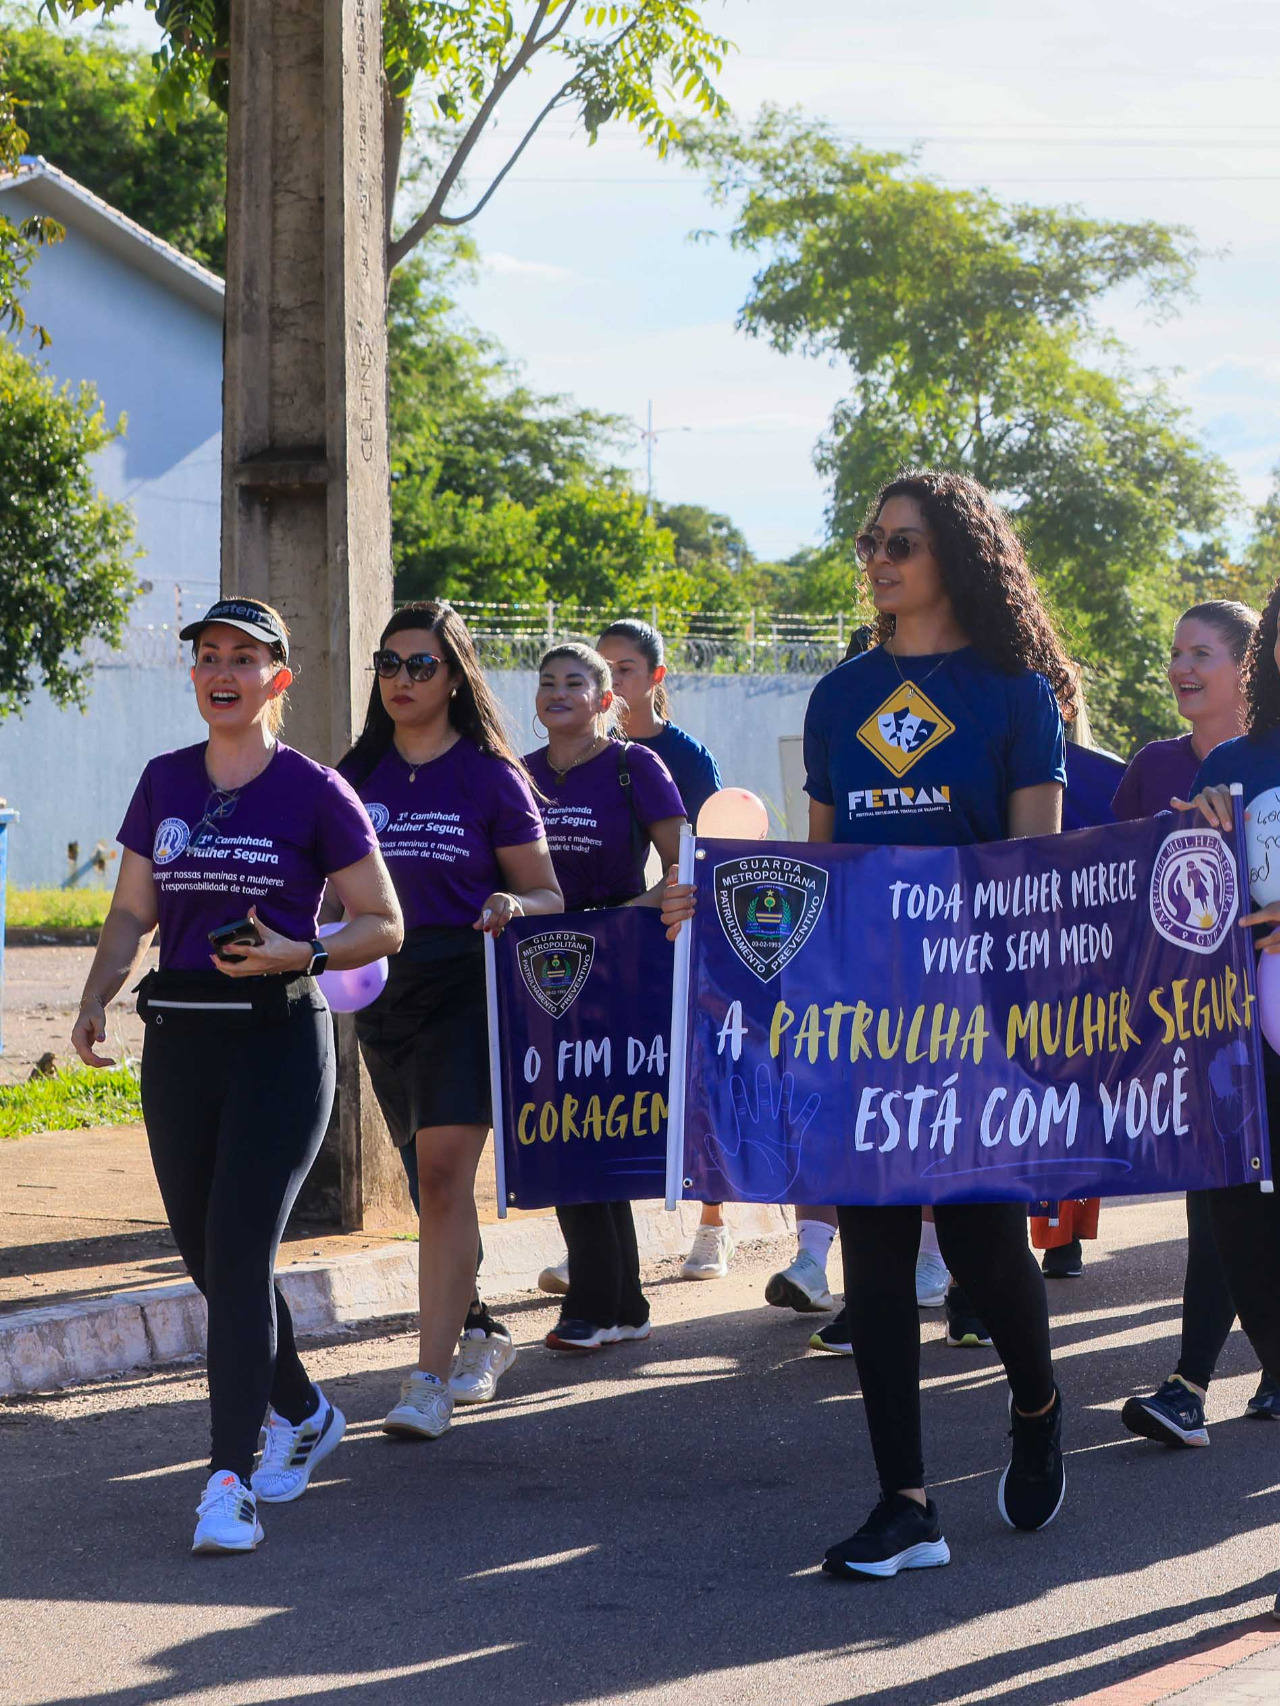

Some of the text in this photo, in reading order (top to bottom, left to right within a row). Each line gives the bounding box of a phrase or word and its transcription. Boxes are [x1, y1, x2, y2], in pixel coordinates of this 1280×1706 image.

[359, 342, 373, 462] CELTINS
[848, 785, 950, 810] FETRAN
[410, 811, 460, 822] Caminhada
[547, 806, 592, 814] Caminhada
[387, 822, 465, 836] Mulher Segura
[561, 815, 597, 828] Segura
[215, 836, 273, 848] Caminhada
[398, 840, 428, 848] meninas
[437, 842, 470, 857] mulheres
[573, 836, 603, 846] mulheres
[1166, 835, 1222, 855] MULHER
[232, 848, 279, 864] Segura
[420, 849, 430, 857] de
[432, 851, 456, 862] todos!
[739, 859, 801, 873] GUARDA
[165, 882, 228, 892] responsabilidade
[230, 884, 241, 893] de
[242, 886, 268, 896] todos!
[174, 871, 201, 879] nossas
[203, 871, 238, 881] meninas
[247, 874, 285, 887] mulheres
[722, 870, 816, 891] METROPOLITANA
[1220, 852, 1234, 912] SEGURA
[889, 859, 1137, 922] TODA MULHER MERECE
[1153, 856, 1174, 931] PATRULHA
[533, 933, 577, 944] GUARDA
[720, 890, 766, 973] PATRULHAMENTO
[771, 895, 820, 970] PREVENTIVO
[522, 941, 587, 957] METROPOLITANA
[922, 922, 1113, 975] VIVER SEM MEDO
[522, 959, 557, 1013] PATRULHAMENTO
[560, 954, 591, 1010] PREVENTIVO
[717, 1000, 748, 1061] A
[769, 1000, 989, 1064] PATRULHA
[1006, 986, 1142, 1060] MULHER
[523, 1034, 668, 1083] O FIM DA
[855, 1047, 1189, 1155] ESTÁ COM VOCÊ
